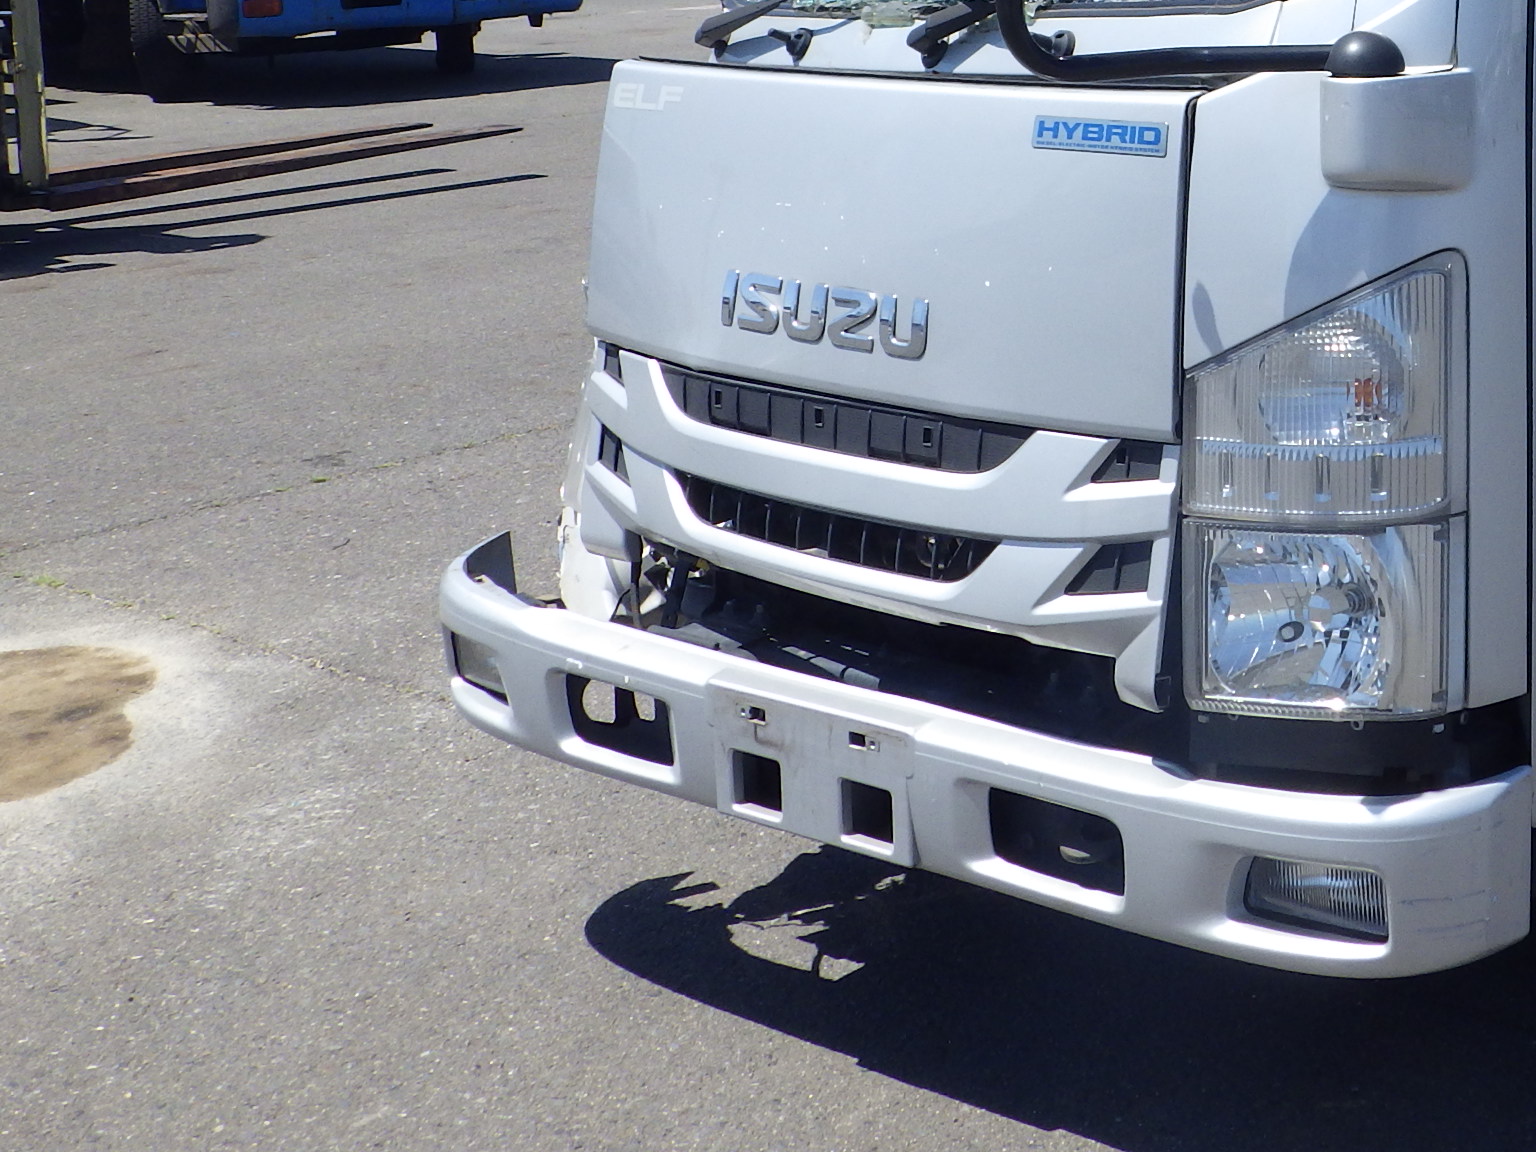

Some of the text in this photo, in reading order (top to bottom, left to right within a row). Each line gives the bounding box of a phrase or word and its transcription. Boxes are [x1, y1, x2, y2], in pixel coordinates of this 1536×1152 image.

[613, 82, 684, 111] ELF
[1037, 120, 1162, 146] HYBRID
[721, 269, 929, 361] ISUZU
